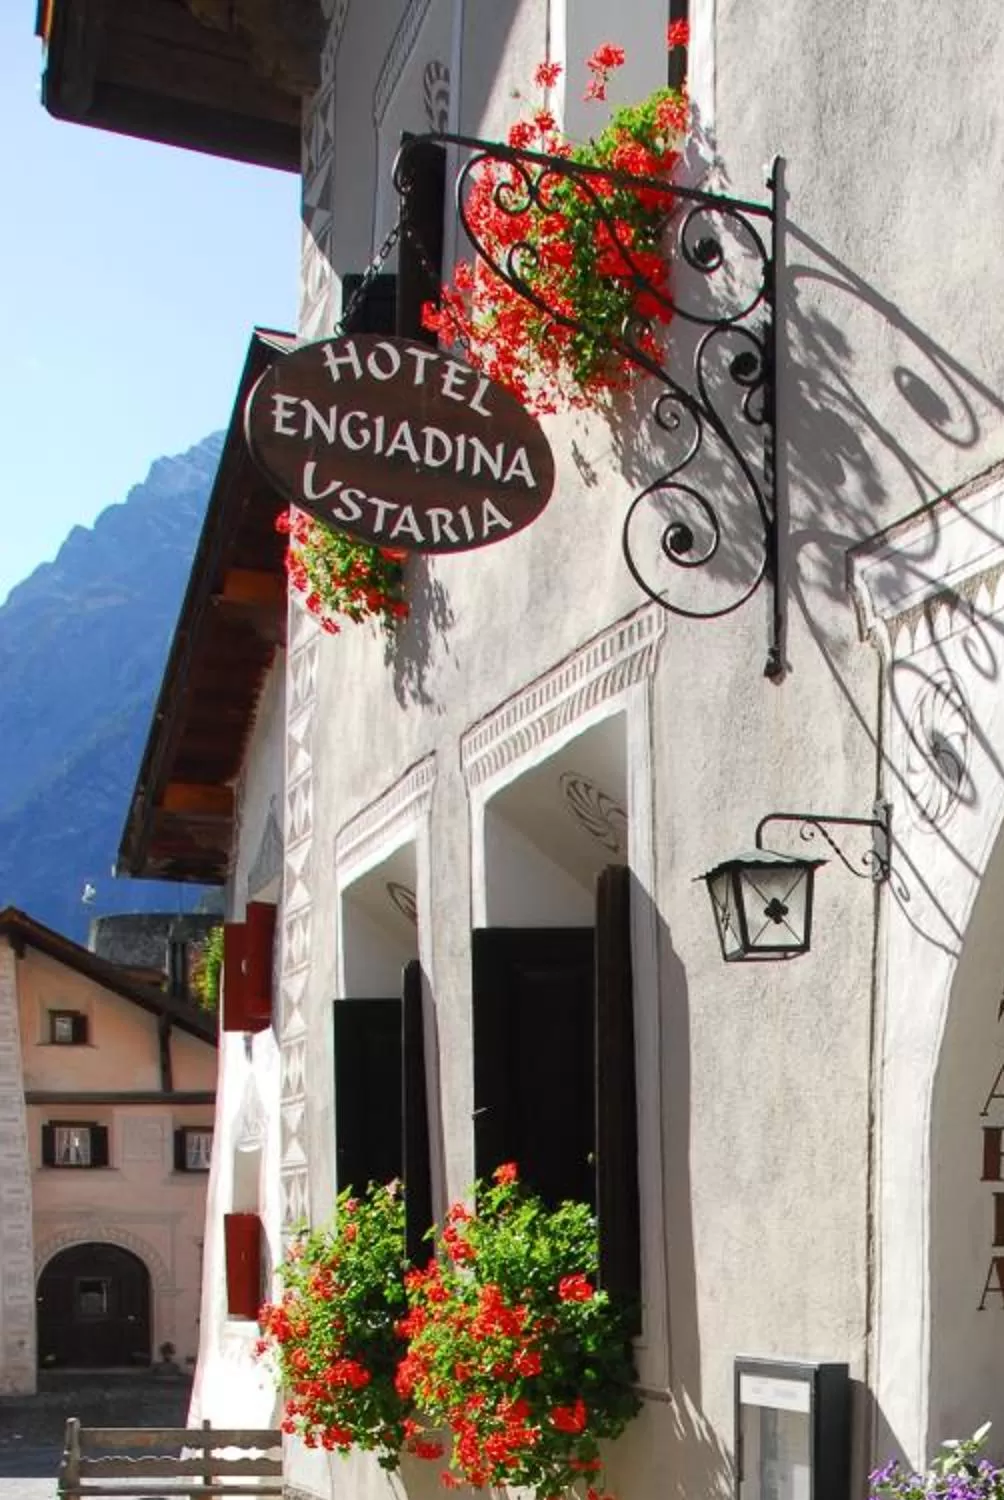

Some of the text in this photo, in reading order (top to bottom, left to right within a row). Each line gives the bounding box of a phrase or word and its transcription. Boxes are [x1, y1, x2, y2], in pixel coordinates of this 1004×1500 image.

[322, 339, 494, 418] HOTEL
[270, 393, 538, 489] ENGIADINA
[302, 461, 513, 544] USTARIA
